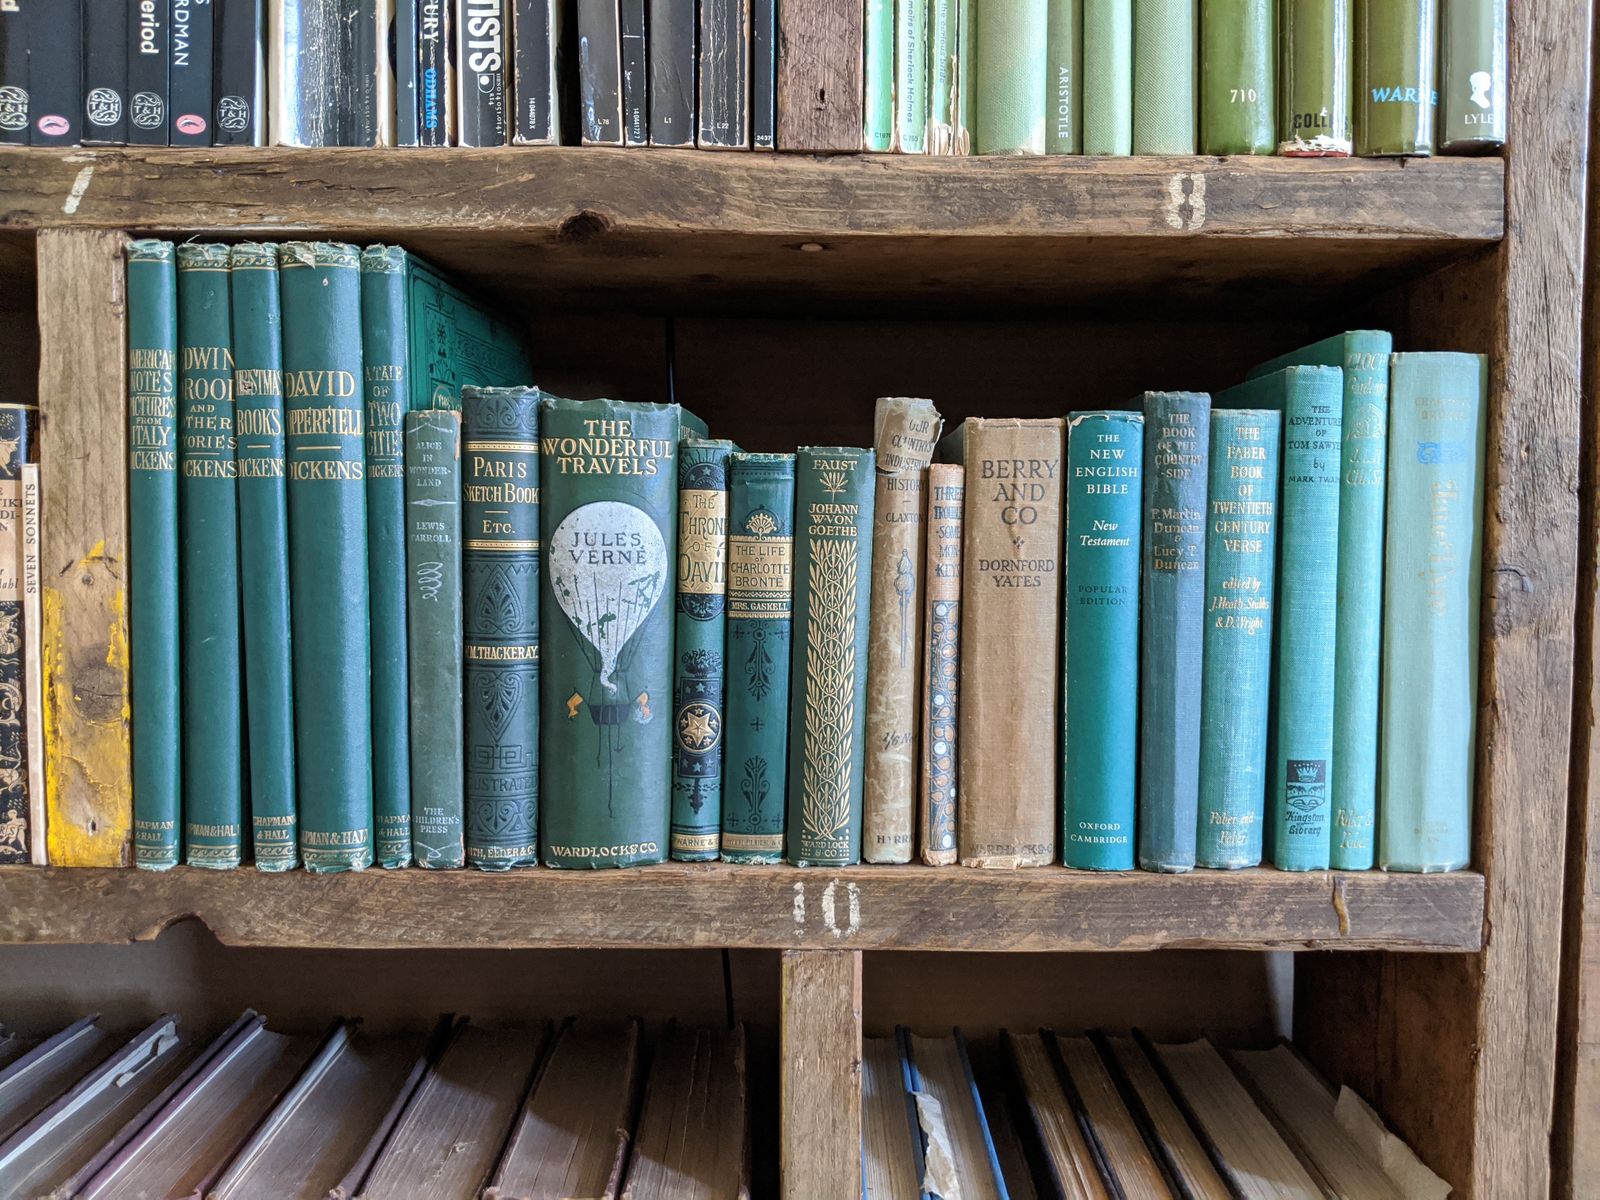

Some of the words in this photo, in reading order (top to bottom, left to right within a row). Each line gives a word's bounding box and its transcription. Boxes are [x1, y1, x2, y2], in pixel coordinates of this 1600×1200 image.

[906, 41, 915, 84] Sherlock
[425, 68, 437, 128] ODHAMS
[1058, 66, 1069, 138] ARISTOTLE
[1230, 89, 1256, 102] 710
[906, 86, 915, 123] Holmes
[1464, 113, 1495, 124] LYLE
[1166, 173, 1207, 231] 8
[182, 377, 235, 402] ROO
[286, 370, 356, 398] DAVID
[372, 385, 391, 398] OF
[190, 404, 215, 413] AND
[367, 400, 400, 427] TWO
[136, 416, 162, 425] FROM
[183, 414, 234, 431] THER
[236, 408, 282, 436] BOOKS
[1168, 413, 1190, 425] THE
[584, 419, 632, 437] THE
[1162, 427, 1197, 438] BOOK
[1235, 426, 1261, 441] THE
[131, 425, 172, 446] ITALY
[1097, 434, 1121, 443] THE
[416, 441, 442, 450] ALICE
[541, 438, 674, 459] WONDERFUL
[1288, 441, 1310, 449] TOM
[1312, 441, 1341, 450] SAWYE
[422, 454, 433, 462] IN
[1090, 449, 1126, 460] NEW
[1227, 446, 1266, 460] FABER
[182, 459, 237, 479] ICKENS
[556, 456, 658, 475] TRAVELS
[812, 459, 858, 471] FAUST
[981, 459, 1060, 479] BERRY
[1313, 458, 1325, 471] by
[1075, 466, 1139, 478] ENGLISH
[1231, 466, 1265, 479] BOOK
[416, 478, 441, 487] LAND
[1087, 483, 1129, 495] BIBLE
[992, 482, 1046, 502] AND
[1238, 484, 1254, 497] OF
[693, 493, 716, 510] THE
[1213, 501, 1273, 515] TWENTIETH
[25, 483, 36, 544] SONNETS
[808, 503, 858, 515] JOHANN
[1001, 506, 1038, 525] CO
[1162, 507, 1201, 520] Martin
[416, 522, 445, 531] LEWIS
[808, 525, 858, 537] GOETHE
[1092, 520, 1118, 532] New
[1154, 522, 1200, 534] Duncan
[1215, 521, 1271, 534] CENTURY
[571, 532, 643, 548] JULES
[692, 540, 712, 552] OF
[1079, 535, 1131, 547] Testament
[1224, 539, 1263, 553] VERSE
[736, 545, 756, 556] THE
[759, 545, 786, 556] LIFE
[1154, 545, 1184, 559] Lucy
[568, 549, 648, 566] VERNE
[730, 562, 791, 575] CHARLOTTE
[979, 559, 1056, 573] DORNFORD
[1154, 559, 1200, 570] Duncan
[26, 555, 37, 593] SEVEN
[992, 575, 1042, 588] YATES
[1078, 584, 1128, 594] POPULAR
[750, 601, 789, 612] GASKELL
[1080, 597, 1127, 606] EDITION
[424, 807, 444, 815] THE
[1285, 811, 1325, 822] Kingston
[415, 816, 460, 824] HILDREN'S
[1079, 822, 1121, 831] OXFORD
[264, 830, 289, 839] HALL
[420, 826, 448, 834] PRESS
[801, 841, 826, 849] WARD
[828, 841, 849, 849] LOCK
[1070, 834, 1127, 843] CAMBRIDGE
[793, 878, 861, 938] 10
